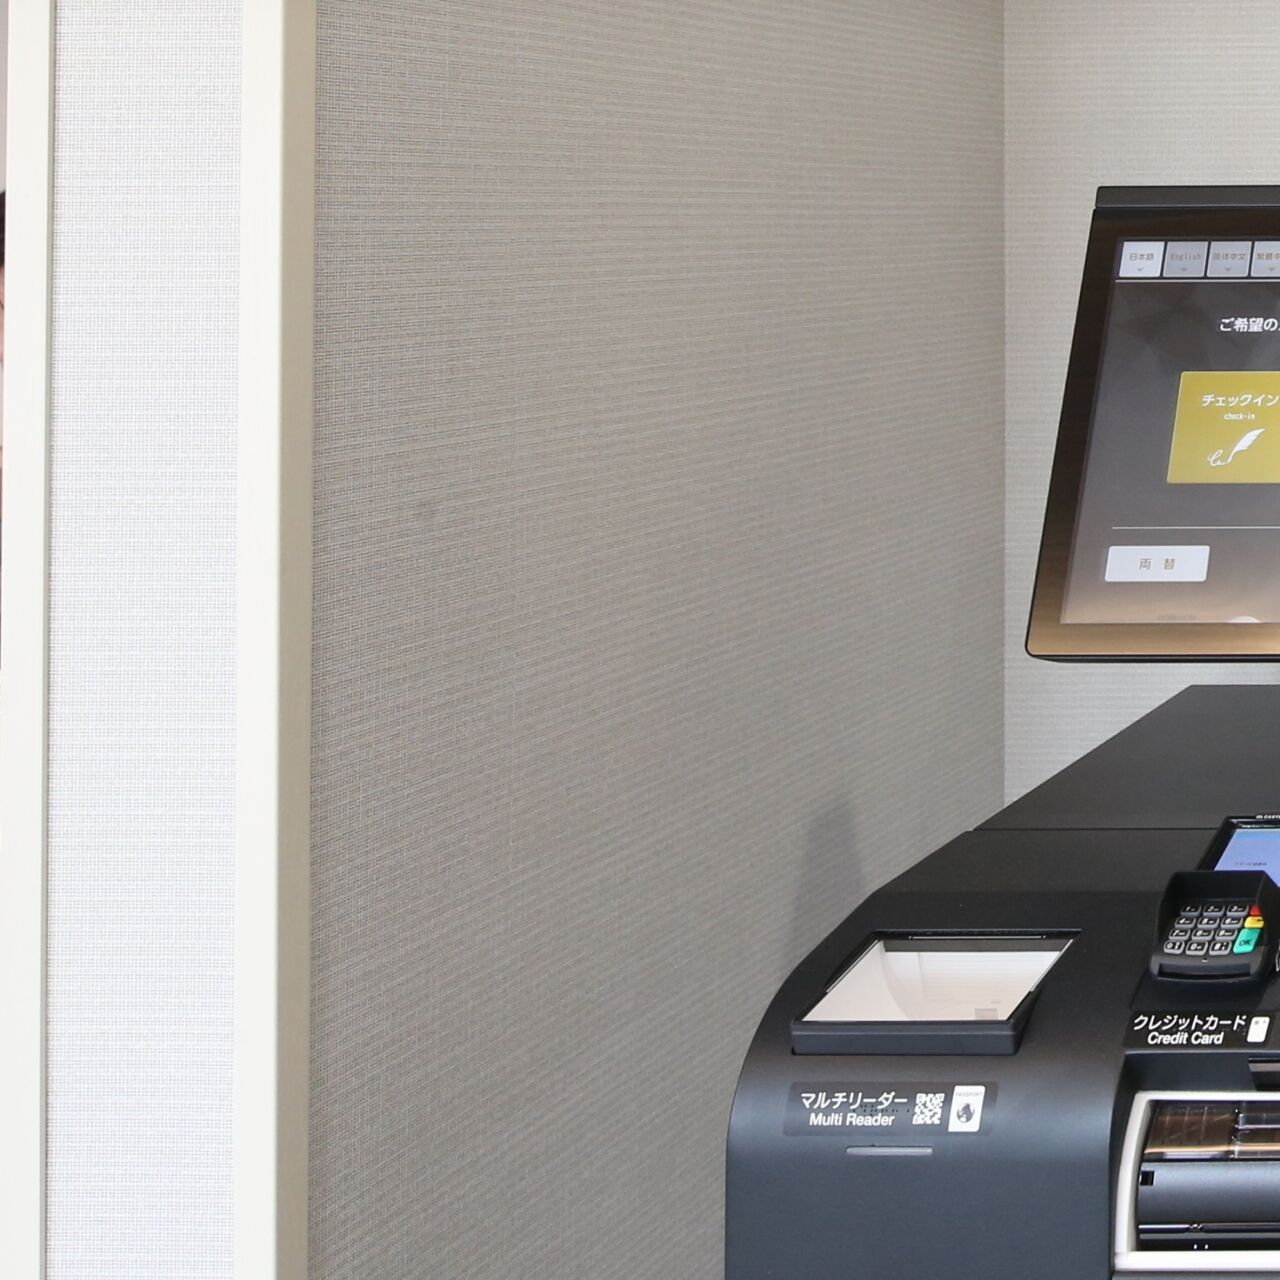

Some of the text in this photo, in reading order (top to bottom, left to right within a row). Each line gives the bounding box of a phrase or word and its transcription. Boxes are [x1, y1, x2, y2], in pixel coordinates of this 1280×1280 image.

[1129, 253, 1154, 261] 日本語
[1170, 252, 1201, 262] English
[1201, 393, 1280, 407] チェックイン
[1224, 412, 1255, 421] check-in
[1133, 1014, 1247, 1031] クレジットカード
[1147, 1031, 1224, 1045] Credit Card
[801, 1091, 908, 1109] マルチリーダー
[809, 1113, 895, 1126] Multi Reader
